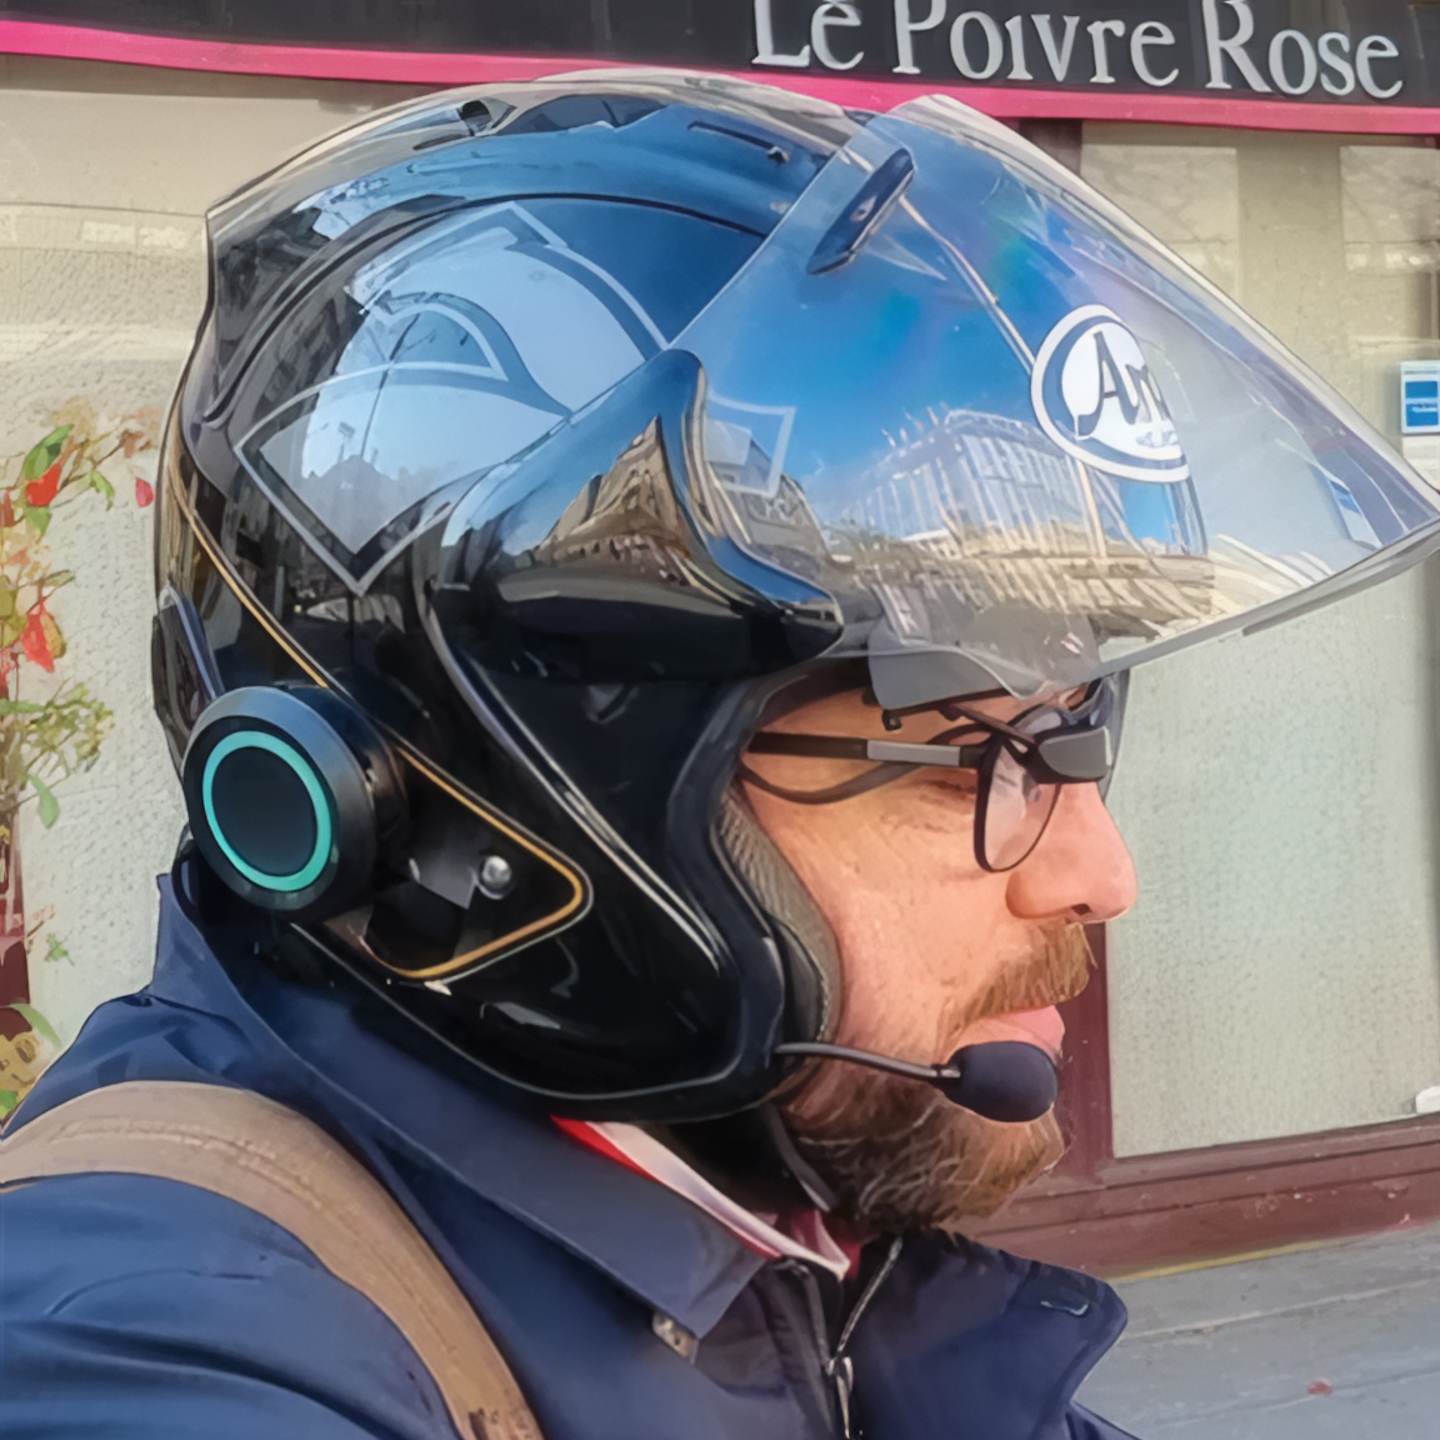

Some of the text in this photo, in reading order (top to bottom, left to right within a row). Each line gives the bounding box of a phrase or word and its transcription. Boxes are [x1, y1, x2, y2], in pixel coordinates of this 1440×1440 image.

[751, 0, 1404, 99] Le Poivre Rose
